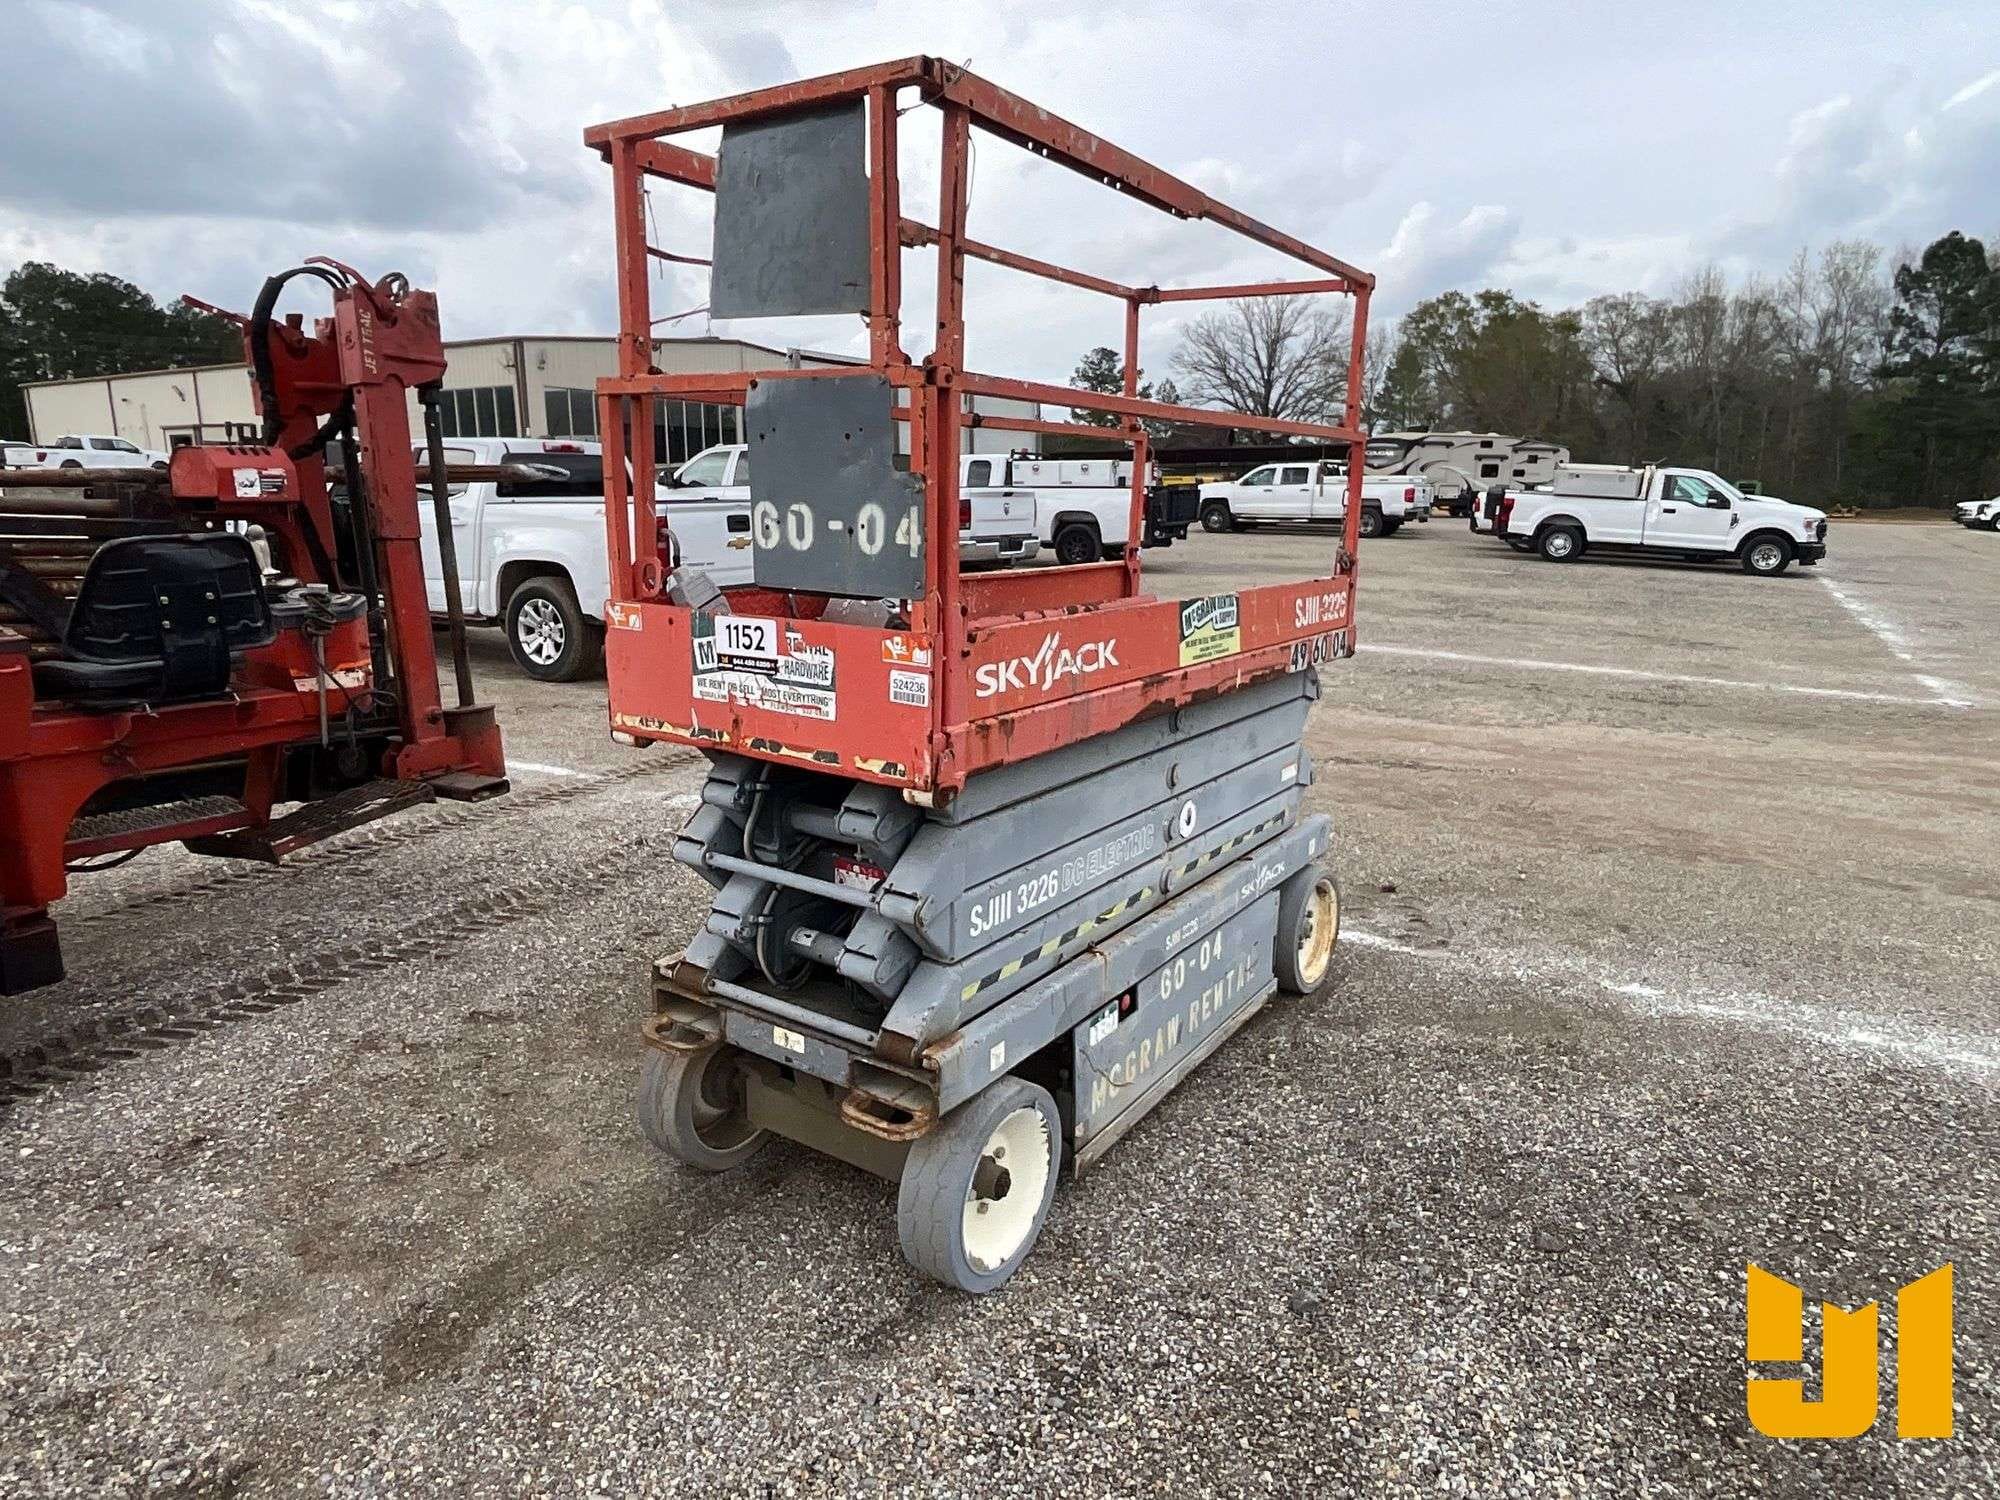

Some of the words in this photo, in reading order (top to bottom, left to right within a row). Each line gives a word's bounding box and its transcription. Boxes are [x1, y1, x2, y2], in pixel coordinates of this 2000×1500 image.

[363, 349, 377, 375] JET
[726, 624, 765, 651] 1152
[784, 660, 829, 681] HARDWARE
[975, 631, 1119, 697] SKYJACK
[697, 678, 708, 688] WE
[709, 679, 726, 692] RENT
[738, 683, 755, 695] SELL
[893, 679, 925, 693] 524236
[1017, 869, 1058, 914] 3226
[1061, 857, 1084, 892] DC
[1087, 823, 1155, 880] ELECTRIC
[1241, 861, 1285, 898] SKYJACK
[1189, 955, 1255, 1033] RENTAL
